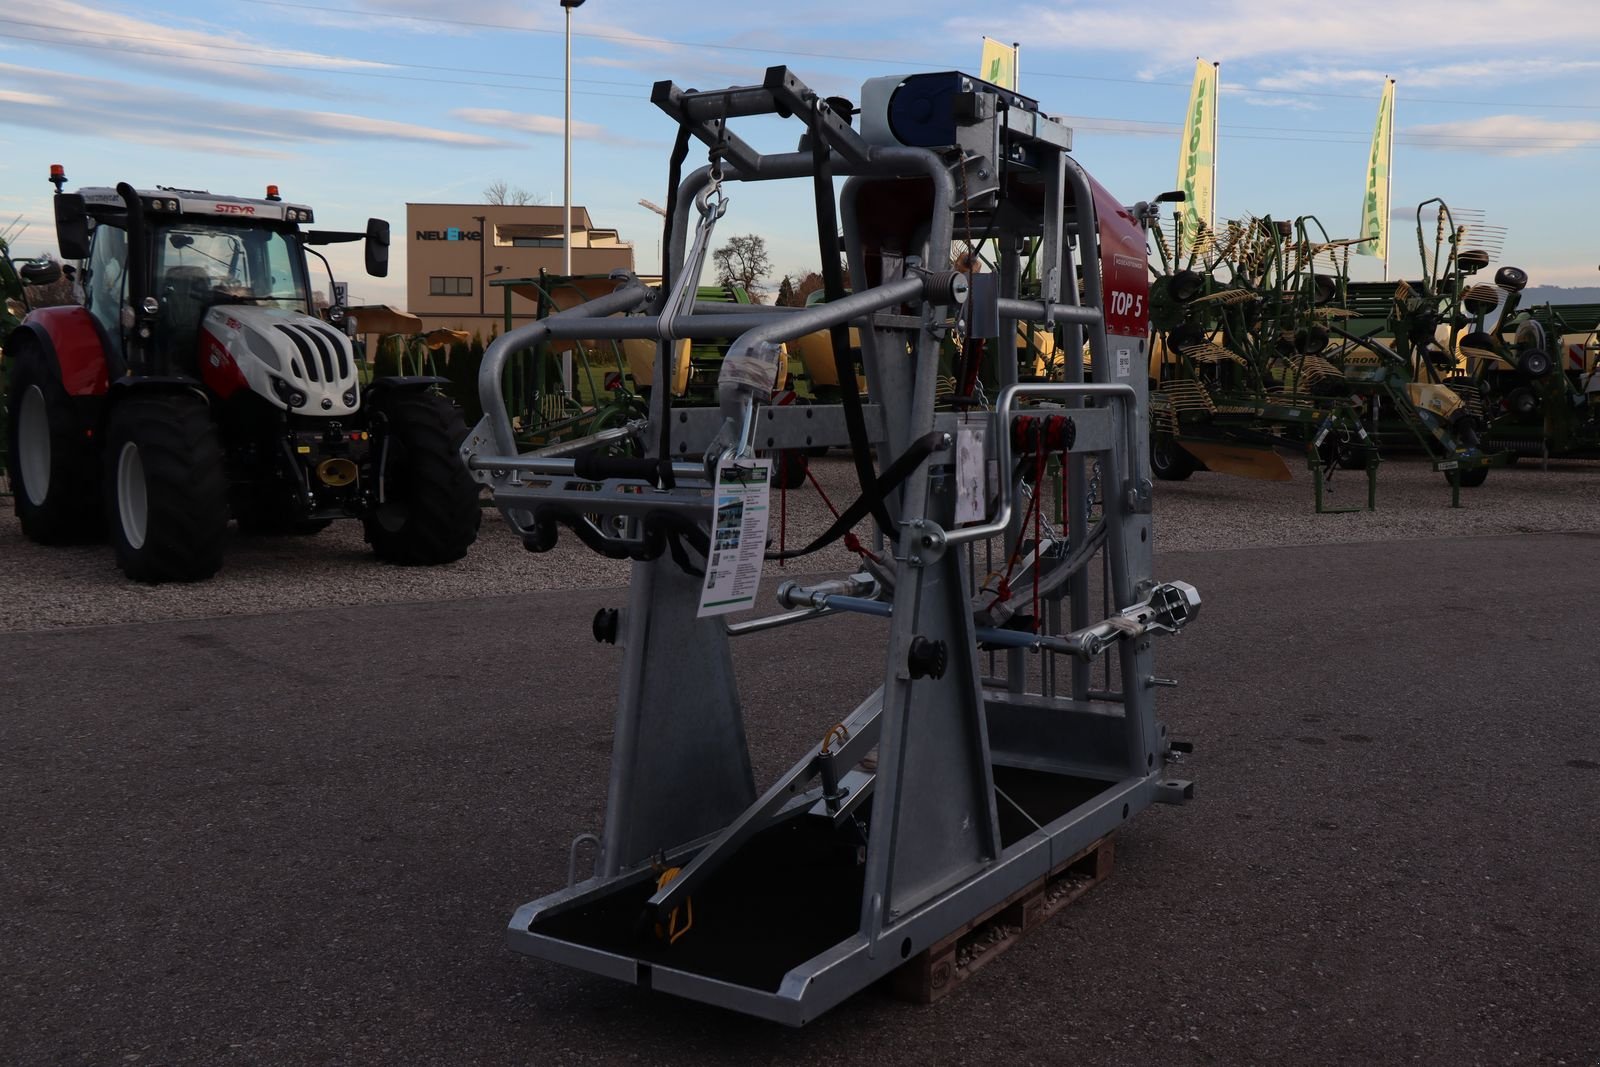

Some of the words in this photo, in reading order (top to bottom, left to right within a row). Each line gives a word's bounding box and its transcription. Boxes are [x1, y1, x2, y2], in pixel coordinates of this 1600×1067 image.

[215, 204, 256, 215] STEYR
[1111, 290, 1133, 317] TOP
[1134, 295, 1143, 318] 5
